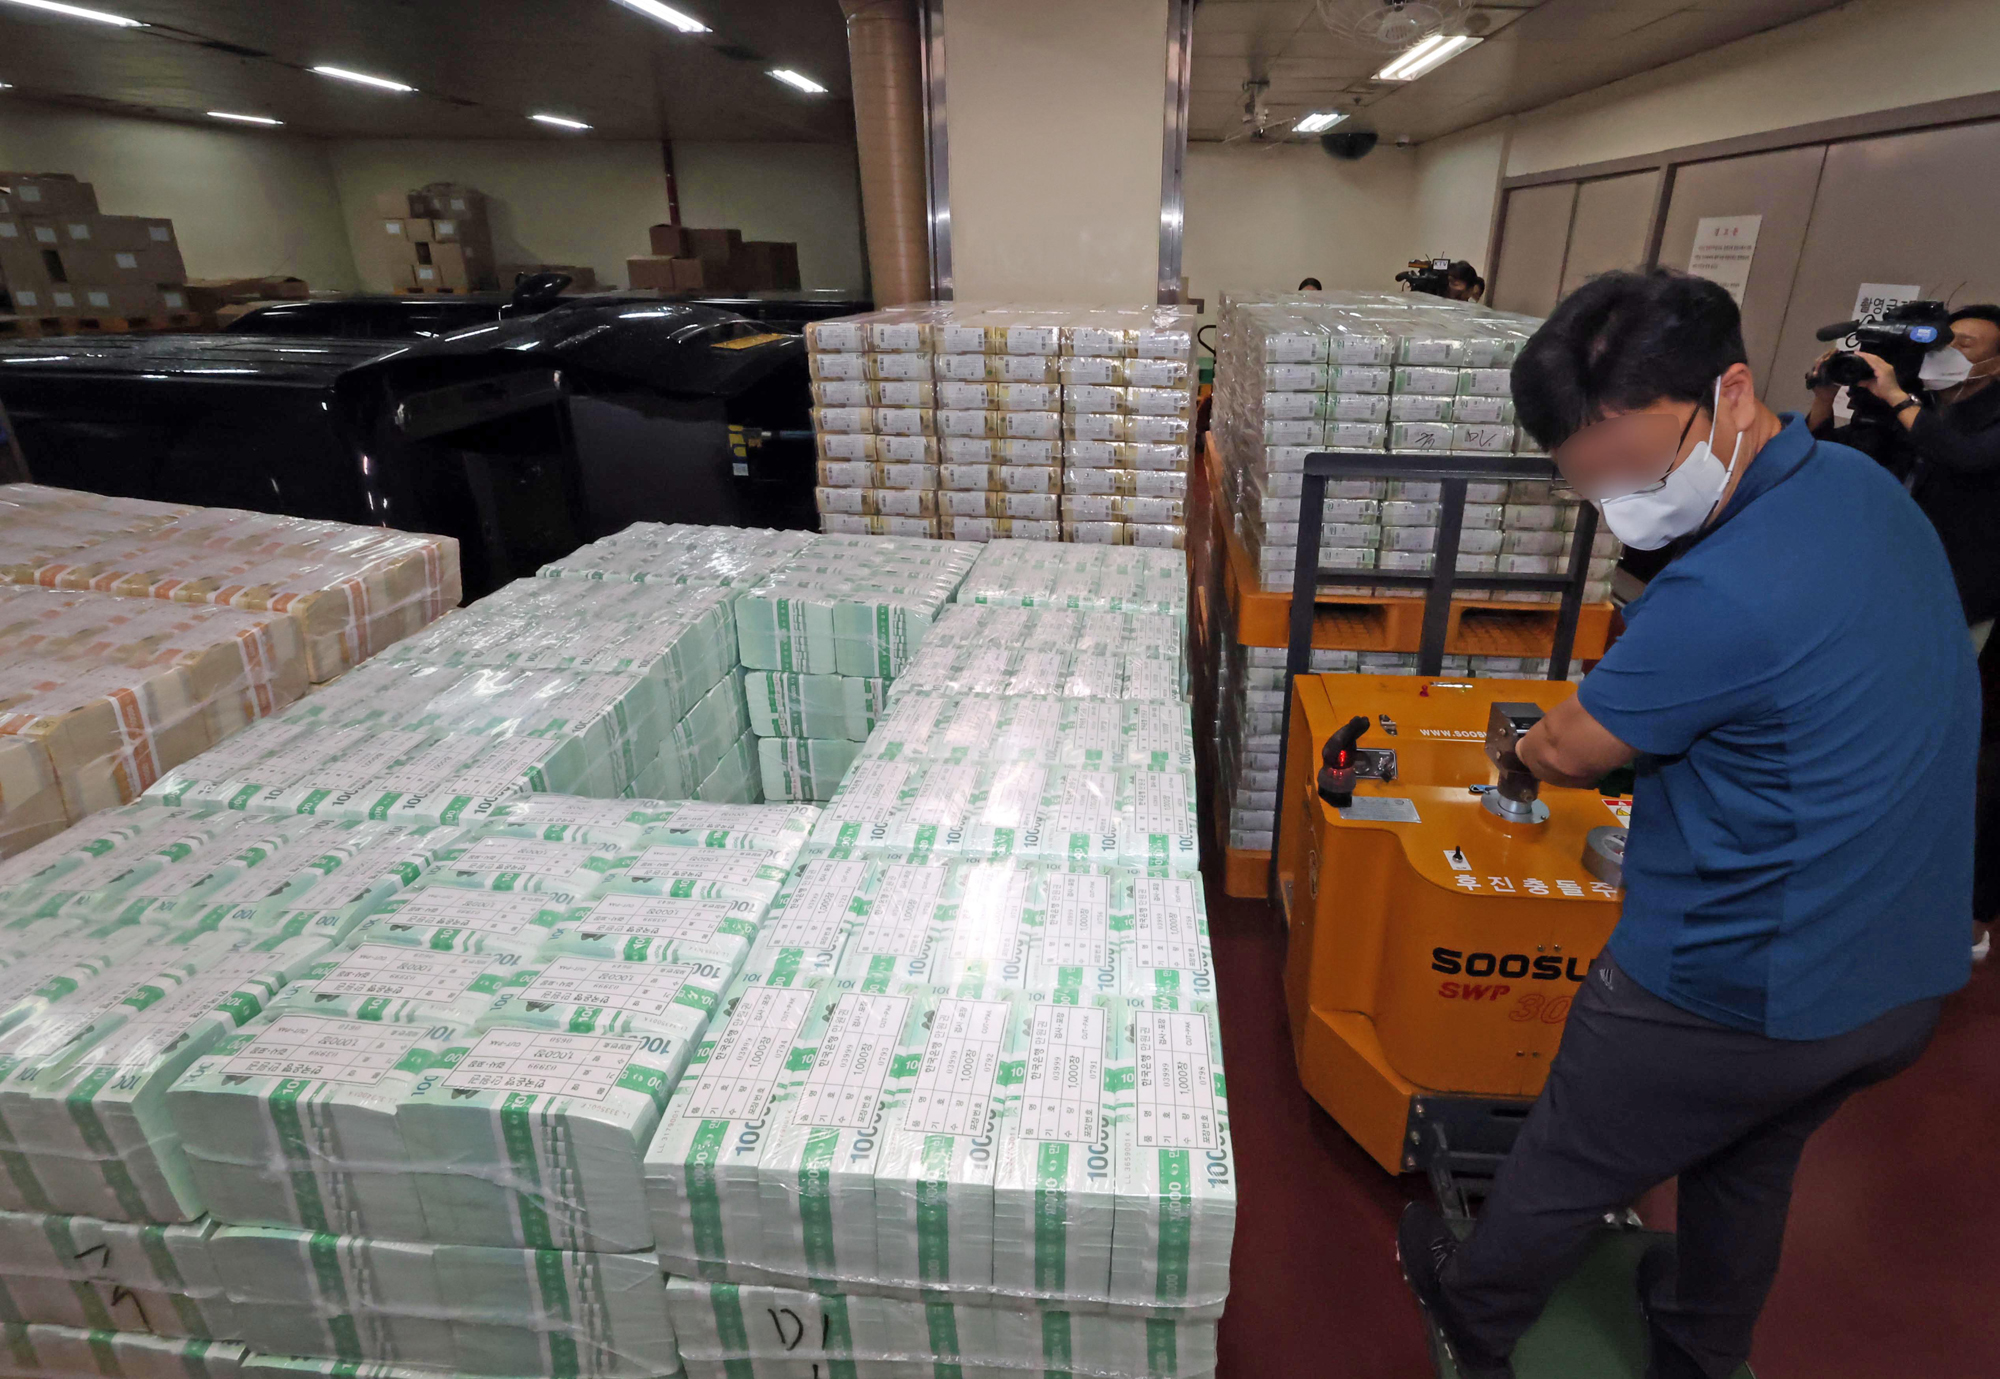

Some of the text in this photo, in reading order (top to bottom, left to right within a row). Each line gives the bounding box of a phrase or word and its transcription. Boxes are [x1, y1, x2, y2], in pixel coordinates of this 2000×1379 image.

[1438, 981, 1511, 1000] SWP
[781, 997, 796, 1022] CUT-PAK
[880, 1004, 892, 1028] CUT-PAK
[982, 1010, 992, 1034] CUT-PAK
[716, 1030, 738, 1060] 한국은행
[736, 1038, 752, 1061] 03999
[749, 1036, 772, 1068] 1,000장
[819, 1036, 838, 1067] 한국은행
[840, 1044, 854, 1068] 03999
[854, 1043, 872, 1076] 1,000장
[926, 1042, 942, 1074] 한국은행
[946, 1050, 958, 1074] 03999
[962, 1050, 976, 1082] 1,000장
[1030, 1048, 1044, 1080] 한국은행
[1052, 1056, 1062, 1080] 03999
[1068, 1055, 1080, 1089] 1,000장
[1140, 1054, 1152, 1087] 한국은행
[1162, 1063, 1170, 1088] 03999
[1178, 1062, 1189, 1095] 1,000장
[748, 1088, 766, 1116] 포장번호
[858, 1094, 872, 1124] 포장번호
[970, 1102, 982, 1131] 포장번호
[1084, 1108, 1094, 1138] 포장번호
[1201, 1114, 1210, 1144] 포장번호
[1049, 1144, 1060, 1154] 만
